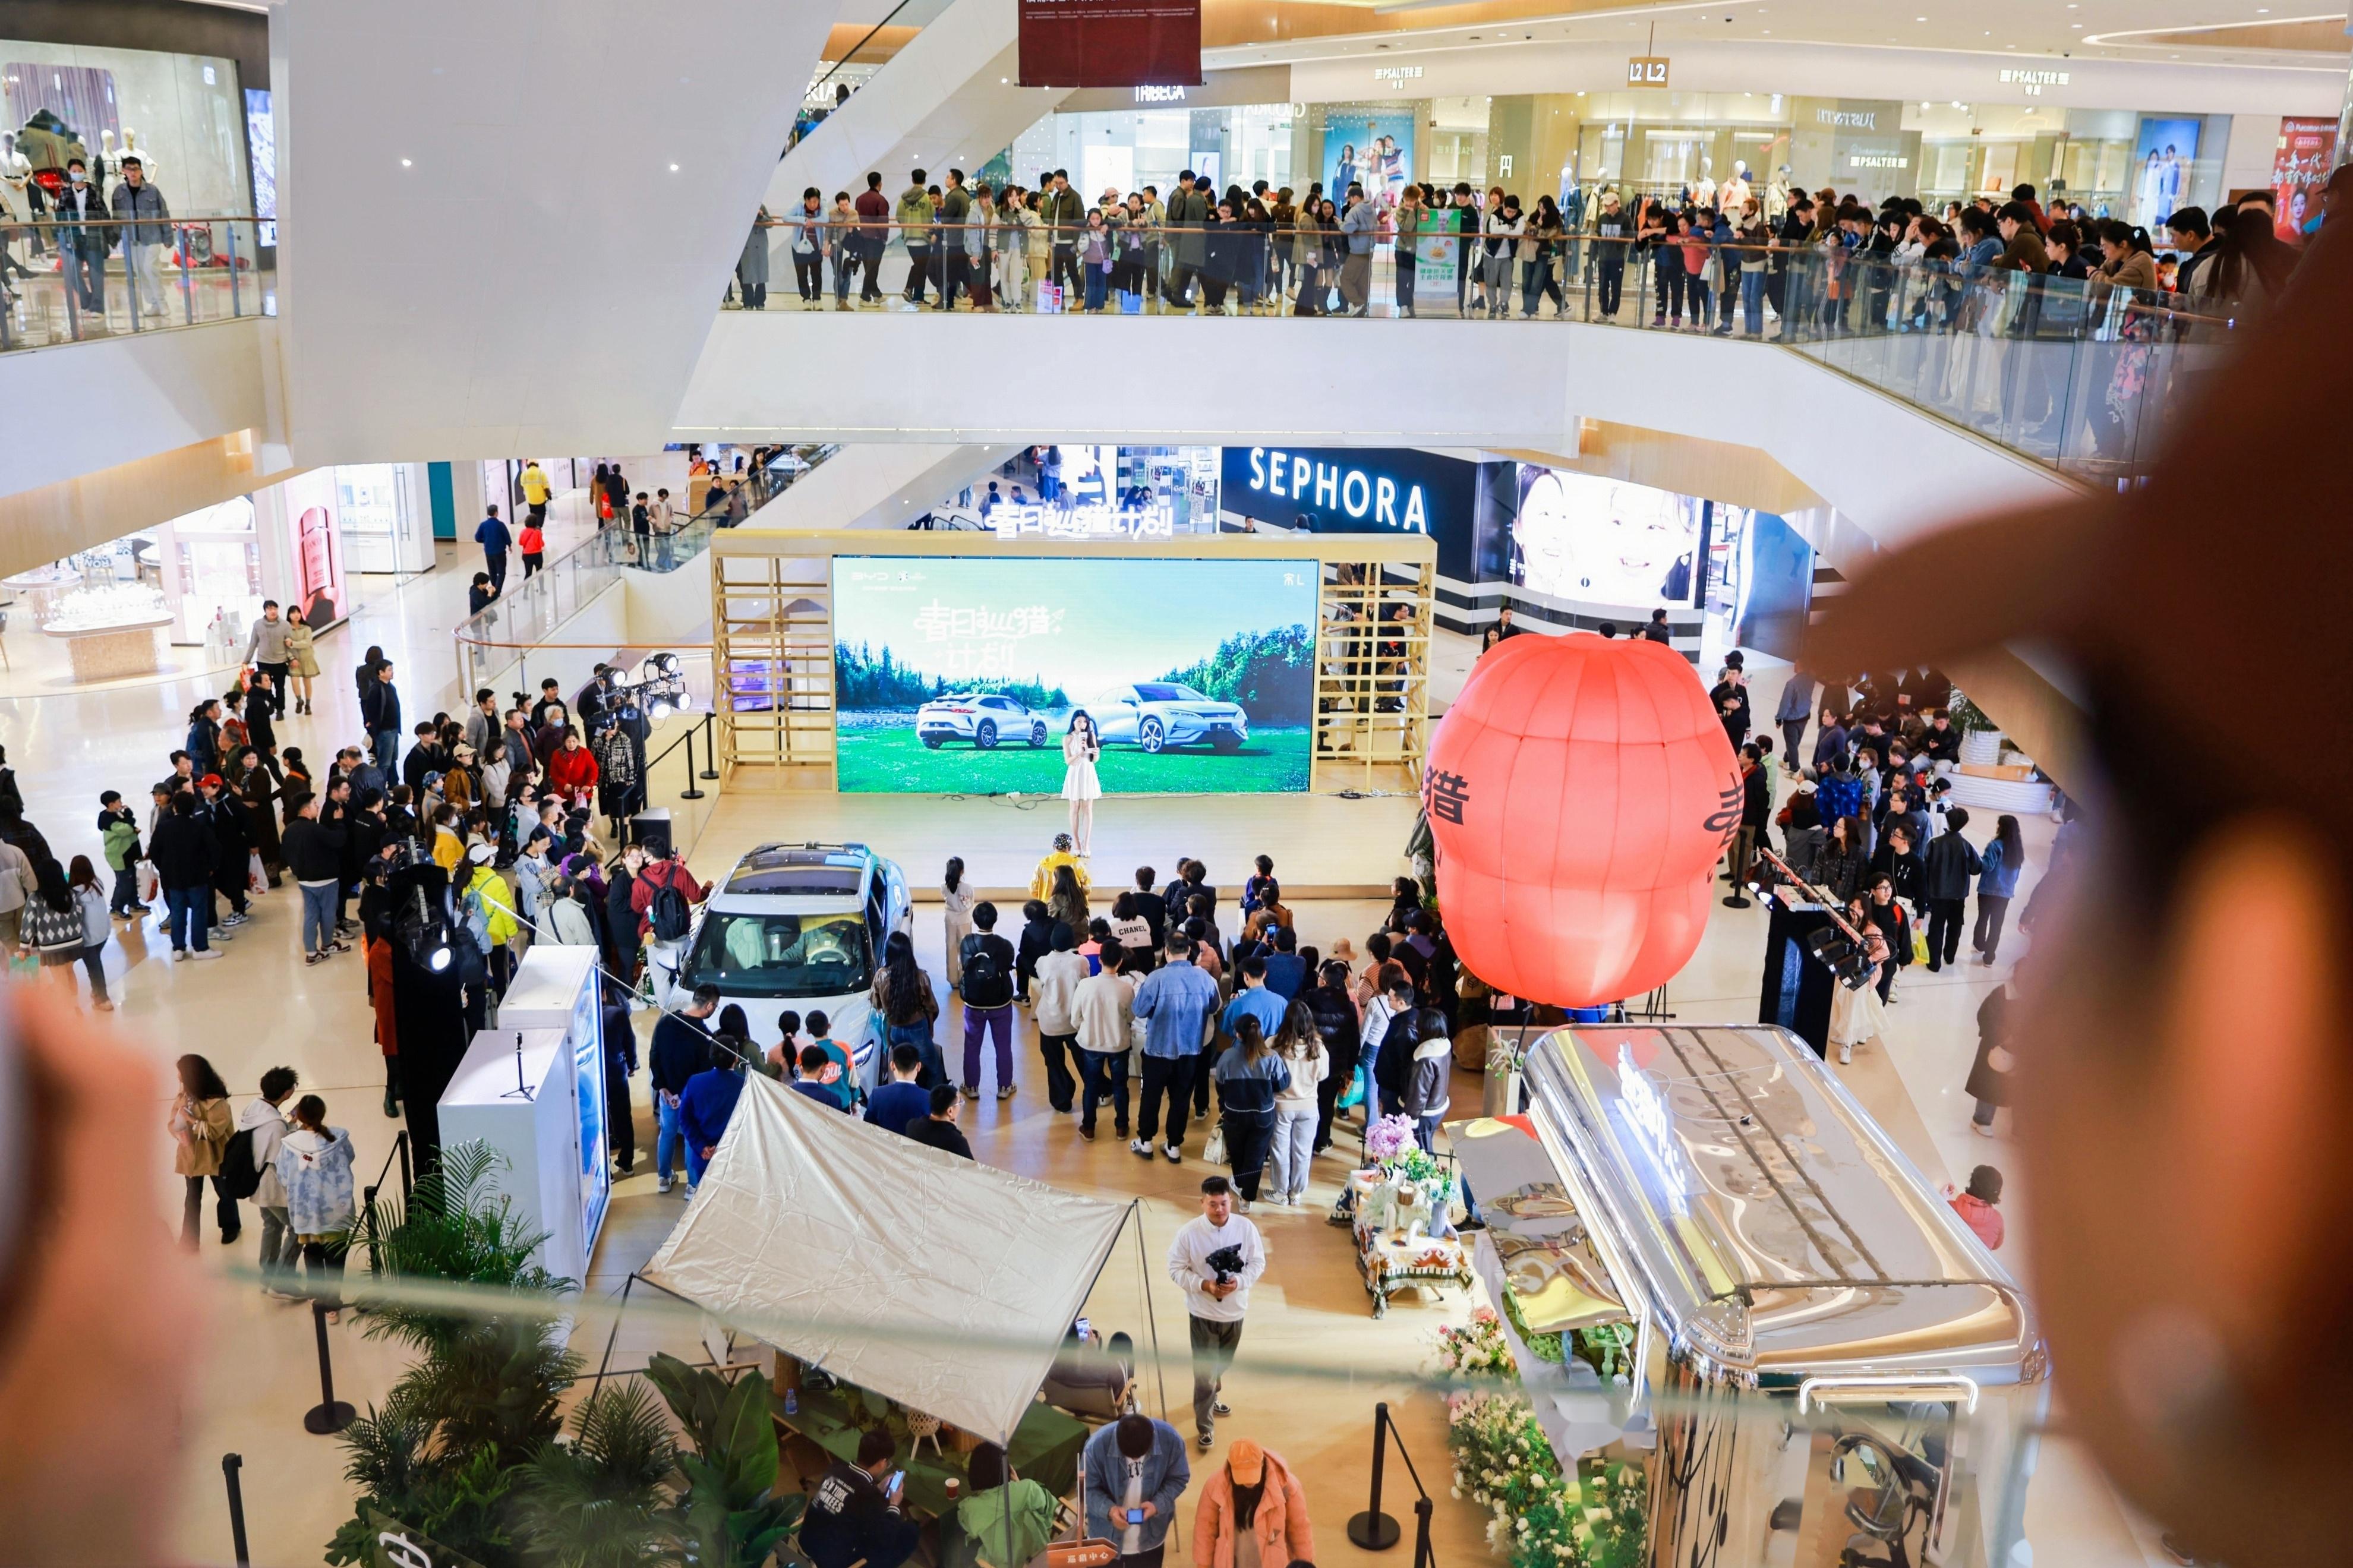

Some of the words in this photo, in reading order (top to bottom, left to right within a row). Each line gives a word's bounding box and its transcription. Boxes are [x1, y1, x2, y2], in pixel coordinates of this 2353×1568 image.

[1383, 67, 1415, 80] PSALTER
[1629, 63, 1642, 81] L2
[1646, 63, 1666, 82] L2
[2011, 70, 2057, 84] PSALTER
[806, 81, 837, 102] RIA
[1860, 156, 1898, 168] PSALTER
[1250, 447, 1427, 534] SEPHORA
[851, 572, 889, 580] BYD
[1118, 925, 1147, 936] CHANEL
[819, 1491, 844, 1513] NKEES
